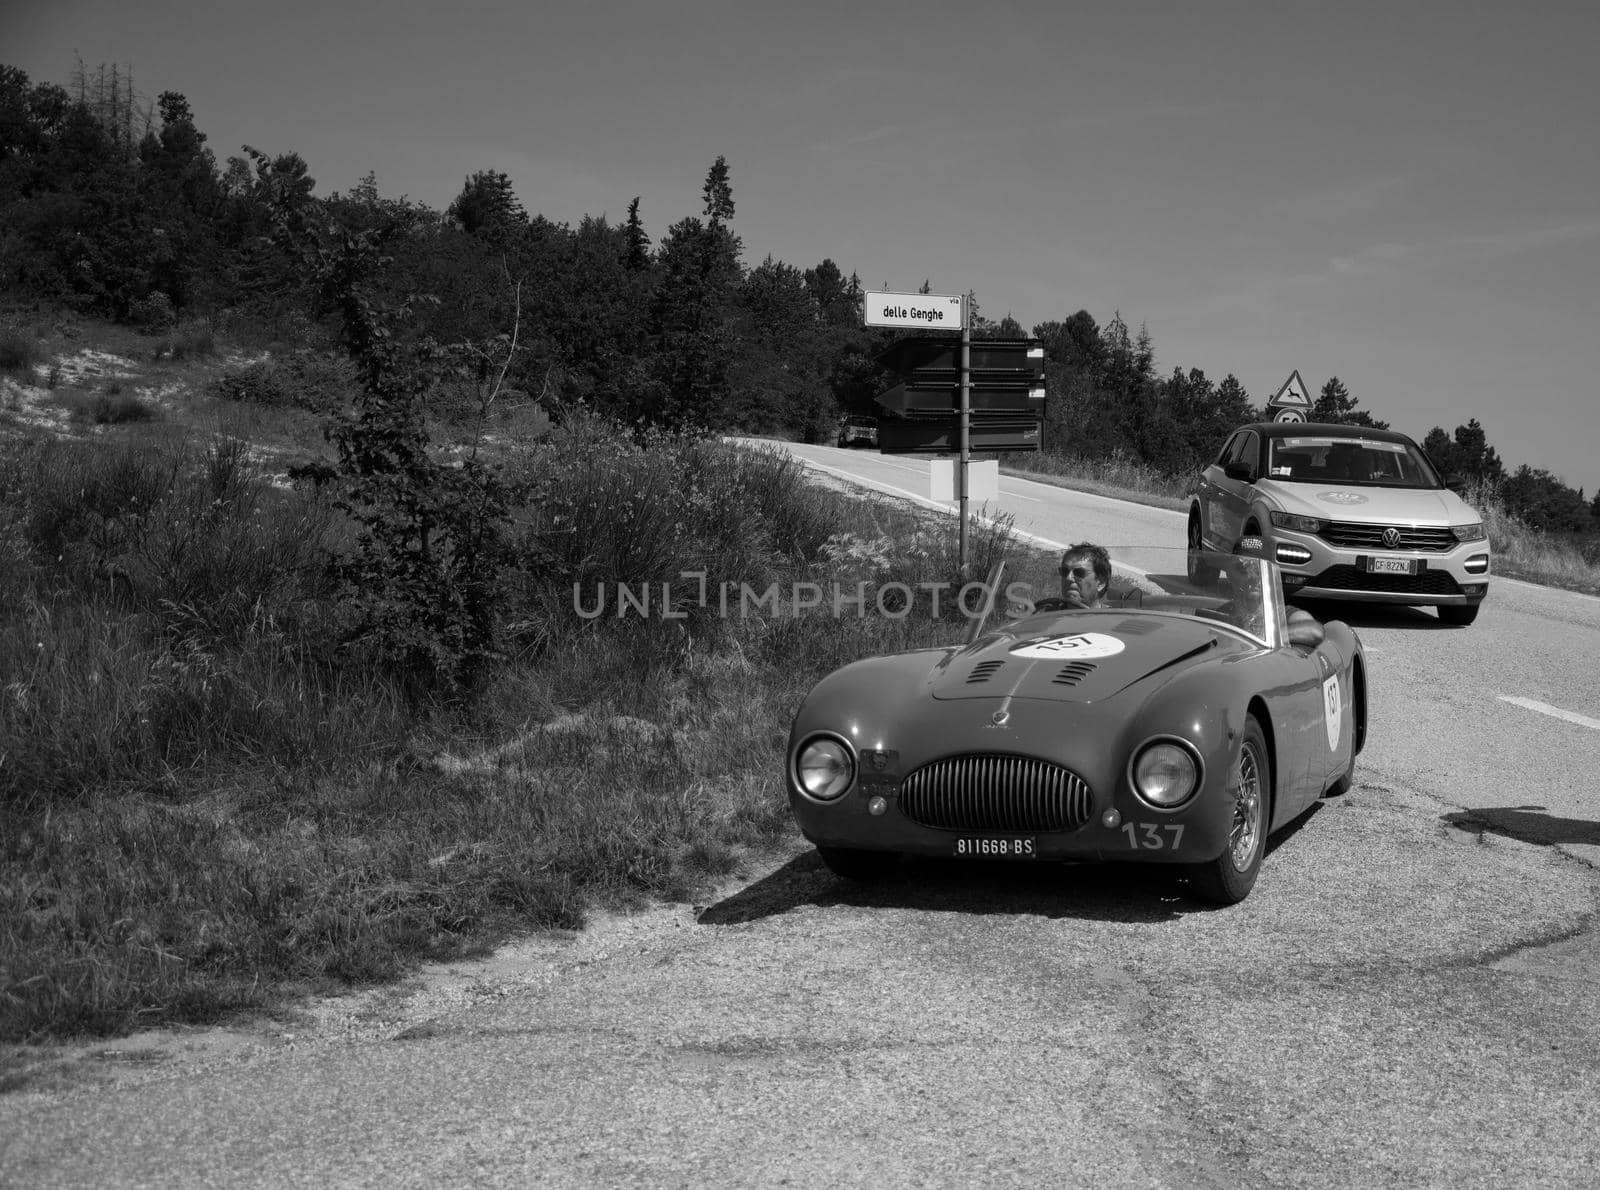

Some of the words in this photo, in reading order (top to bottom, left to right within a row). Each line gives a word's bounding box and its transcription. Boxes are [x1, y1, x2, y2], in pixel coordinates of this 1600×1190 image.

[883, 305, 908, 318] delle
[910, 307, 944, 322] Genghe
[1036, 636, 1093, 652] 137
[1121, 821, 1185, 850] 137
[957, 838, 1008, 854] 811668
[1014, 839, 1033, 854] BS
